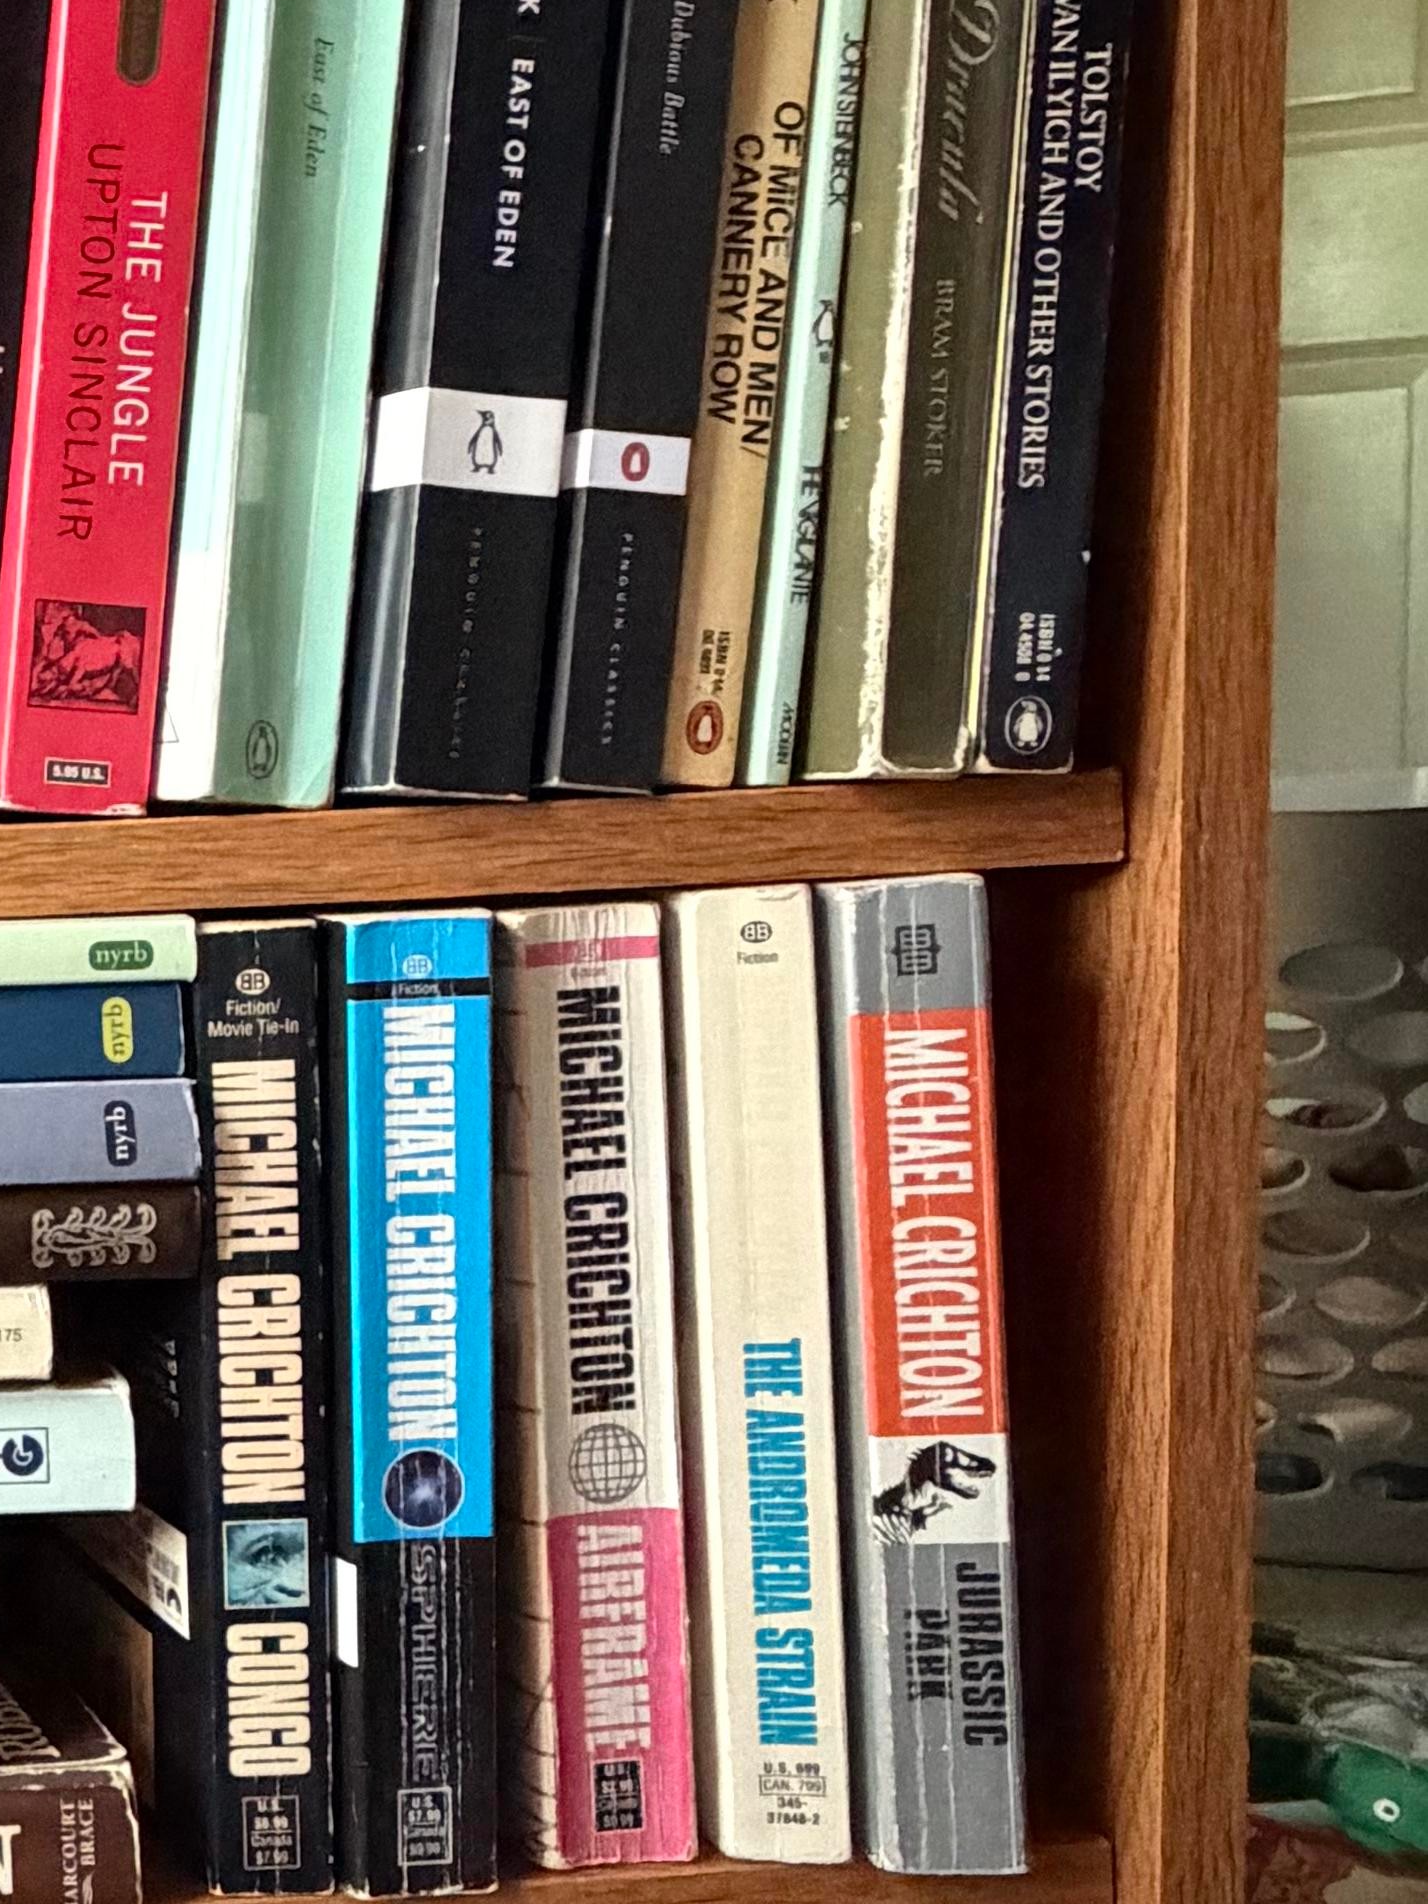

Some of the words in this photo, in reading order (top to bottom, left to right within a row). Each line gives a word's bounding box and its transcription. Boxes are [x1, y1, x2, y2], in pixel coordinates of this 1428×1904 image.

[504, 137, 526, 184] OF
[508, 57, 535, 126] EAST
[1074, 42, 1113, 192] TOLSTOY
[78, 144, 125, 299] UPTON
[124, 192, 167, 283] THE
[494, 188, 518, 269] EDEN
[57, 322, 109, 541] SINCLAIR
[106, 302, 158, 487] JUNGLE
[211, 1058, 297, 1262] MICHAEL
[217, 1272, 306, 1505] CRICHTON
[226, 1621, 311, 1777] CONGO
[576, 1523, 652, 1751] AIRFRAME
